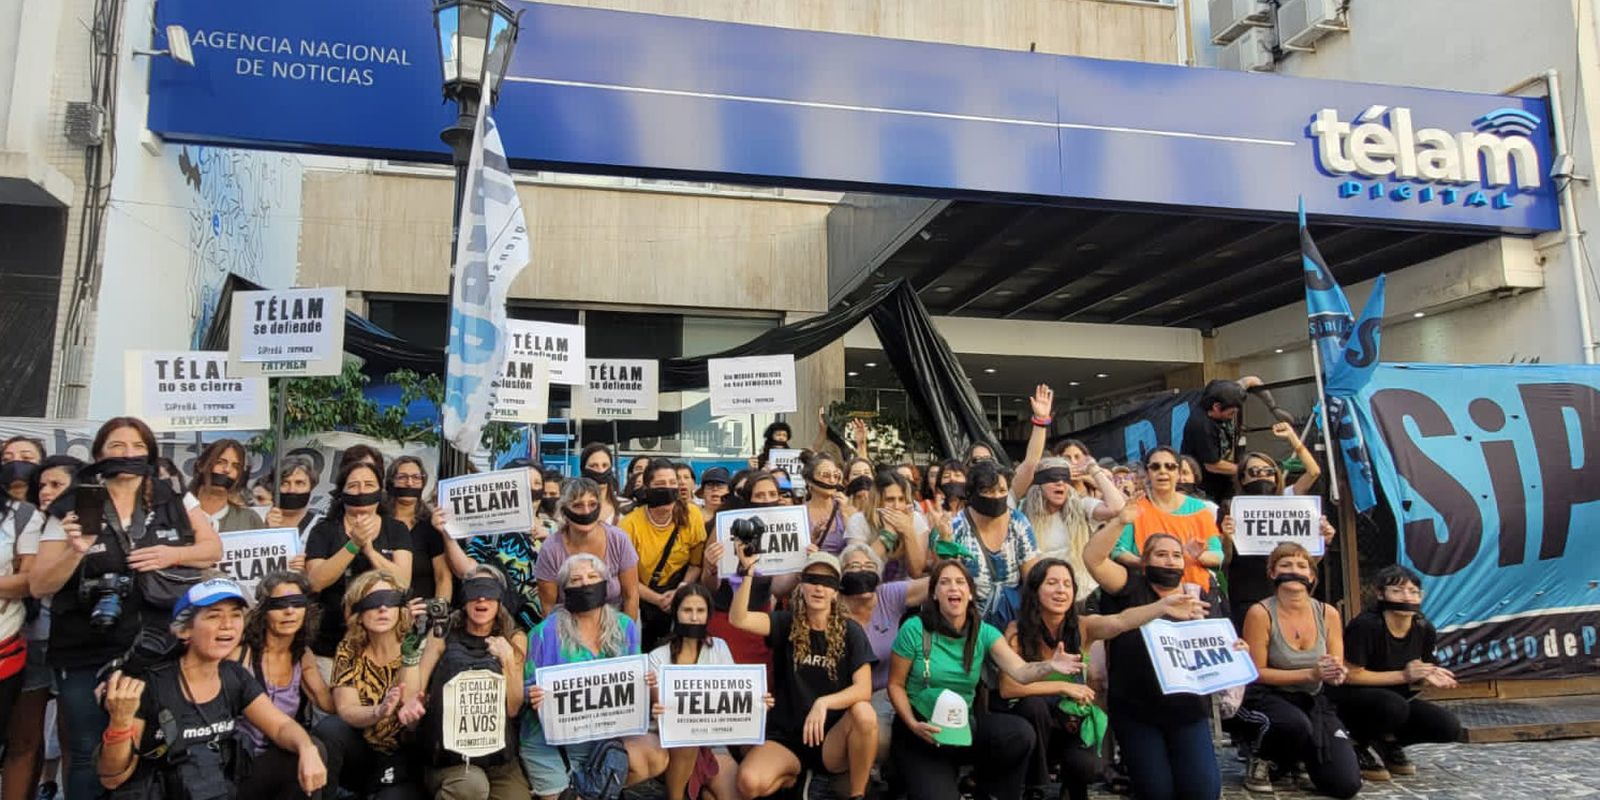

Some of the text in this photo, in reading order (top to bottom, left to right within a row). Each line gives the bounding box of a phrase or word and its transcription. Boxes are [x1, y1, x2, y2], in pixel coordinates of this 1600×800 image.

[192, 29, 412, 66] AGENCIA NACIONAL
[236, 57, 374, 86] DE NOTICIAS
[1309, 105, 1541, 189] télam
[1339, 181, 1514, 209] DIGITAL
[255, 296, 324, 321] TÉLAM
[253, 320, 322, 335] se defiende
[513, 333, 569, 353] TÉLAM
[155, 357, 227, 380] TÉLA
[588, 363, 643, 381] TÉLAM
[158, 380, 243, 392] no se cierra
[589, 380, 642, 391] se defiende
[449, 480, 518, 496] DEFENDEMOS
[450, 490, 519, 515] TELAM
[1243, 510, 1311, 518] DEFENDEMOS
[1244, 520, 1311, 536] TELAM
[226, 545, 286, 560] ENDEMOS
[460, 680, 498, 692] SI CALLAN
[553, 671, 635, 692] DEFENDEMOS
[674, 679, 752, 690] DEFENDEMOS
[460, 694, 465, 705] A
[553, 682, 635, 715] TELAM
[674, 691, 753, 715] TELAM
[460, 704, 498, 715] TE CALLAN
[459, 714, 497, 733] A VOS
